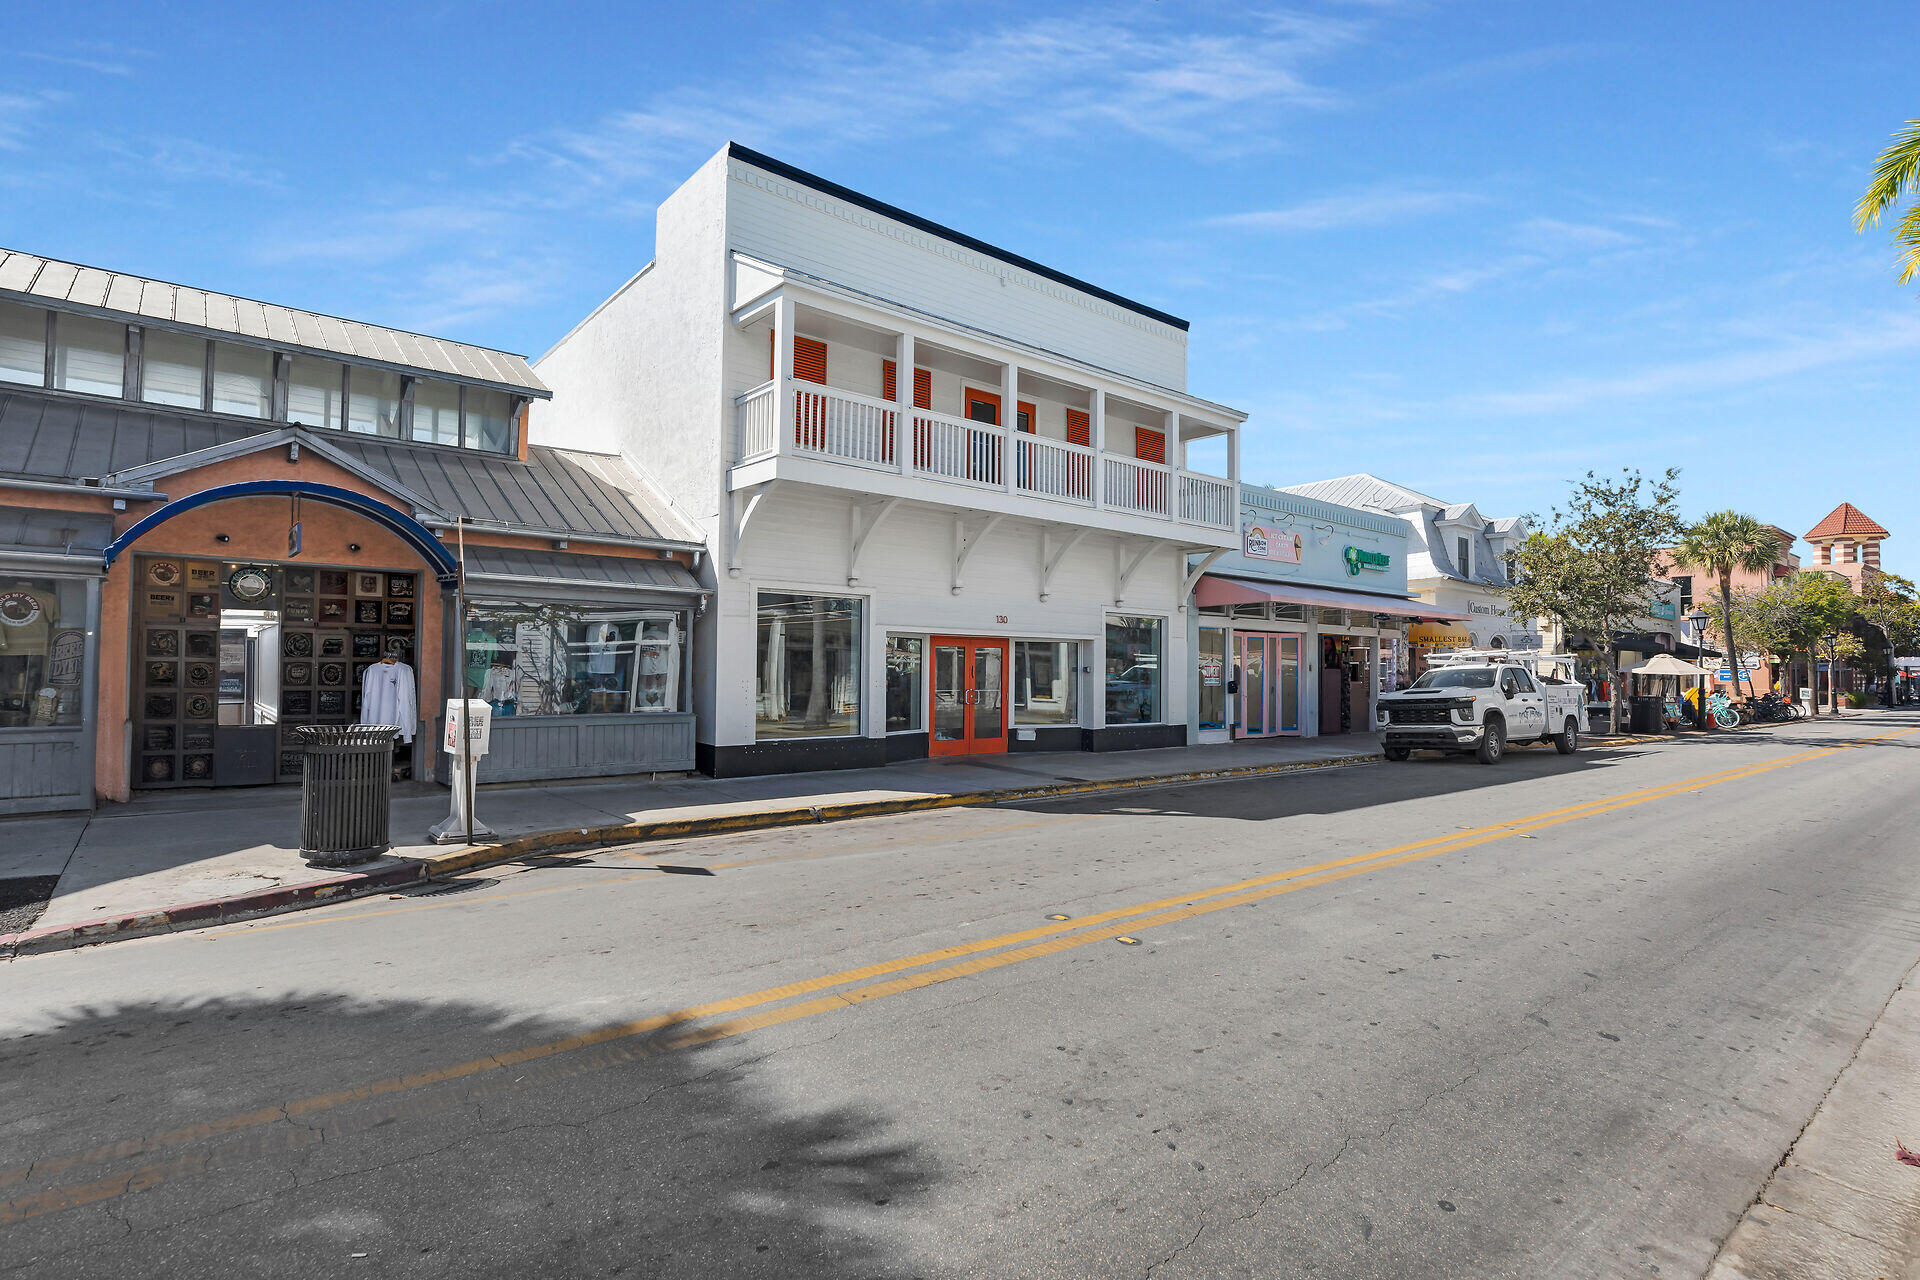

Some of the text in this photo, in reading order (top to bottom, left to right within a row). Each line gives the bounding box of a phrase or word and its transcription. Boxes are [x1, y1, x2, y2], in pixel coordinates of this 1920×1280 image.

[192, 569, 215, 577] BEER
[25, 596, 39, 610] BEER
[1470, 601, 1490, 615] Custom
[996, 615, 1009, 624] 130
